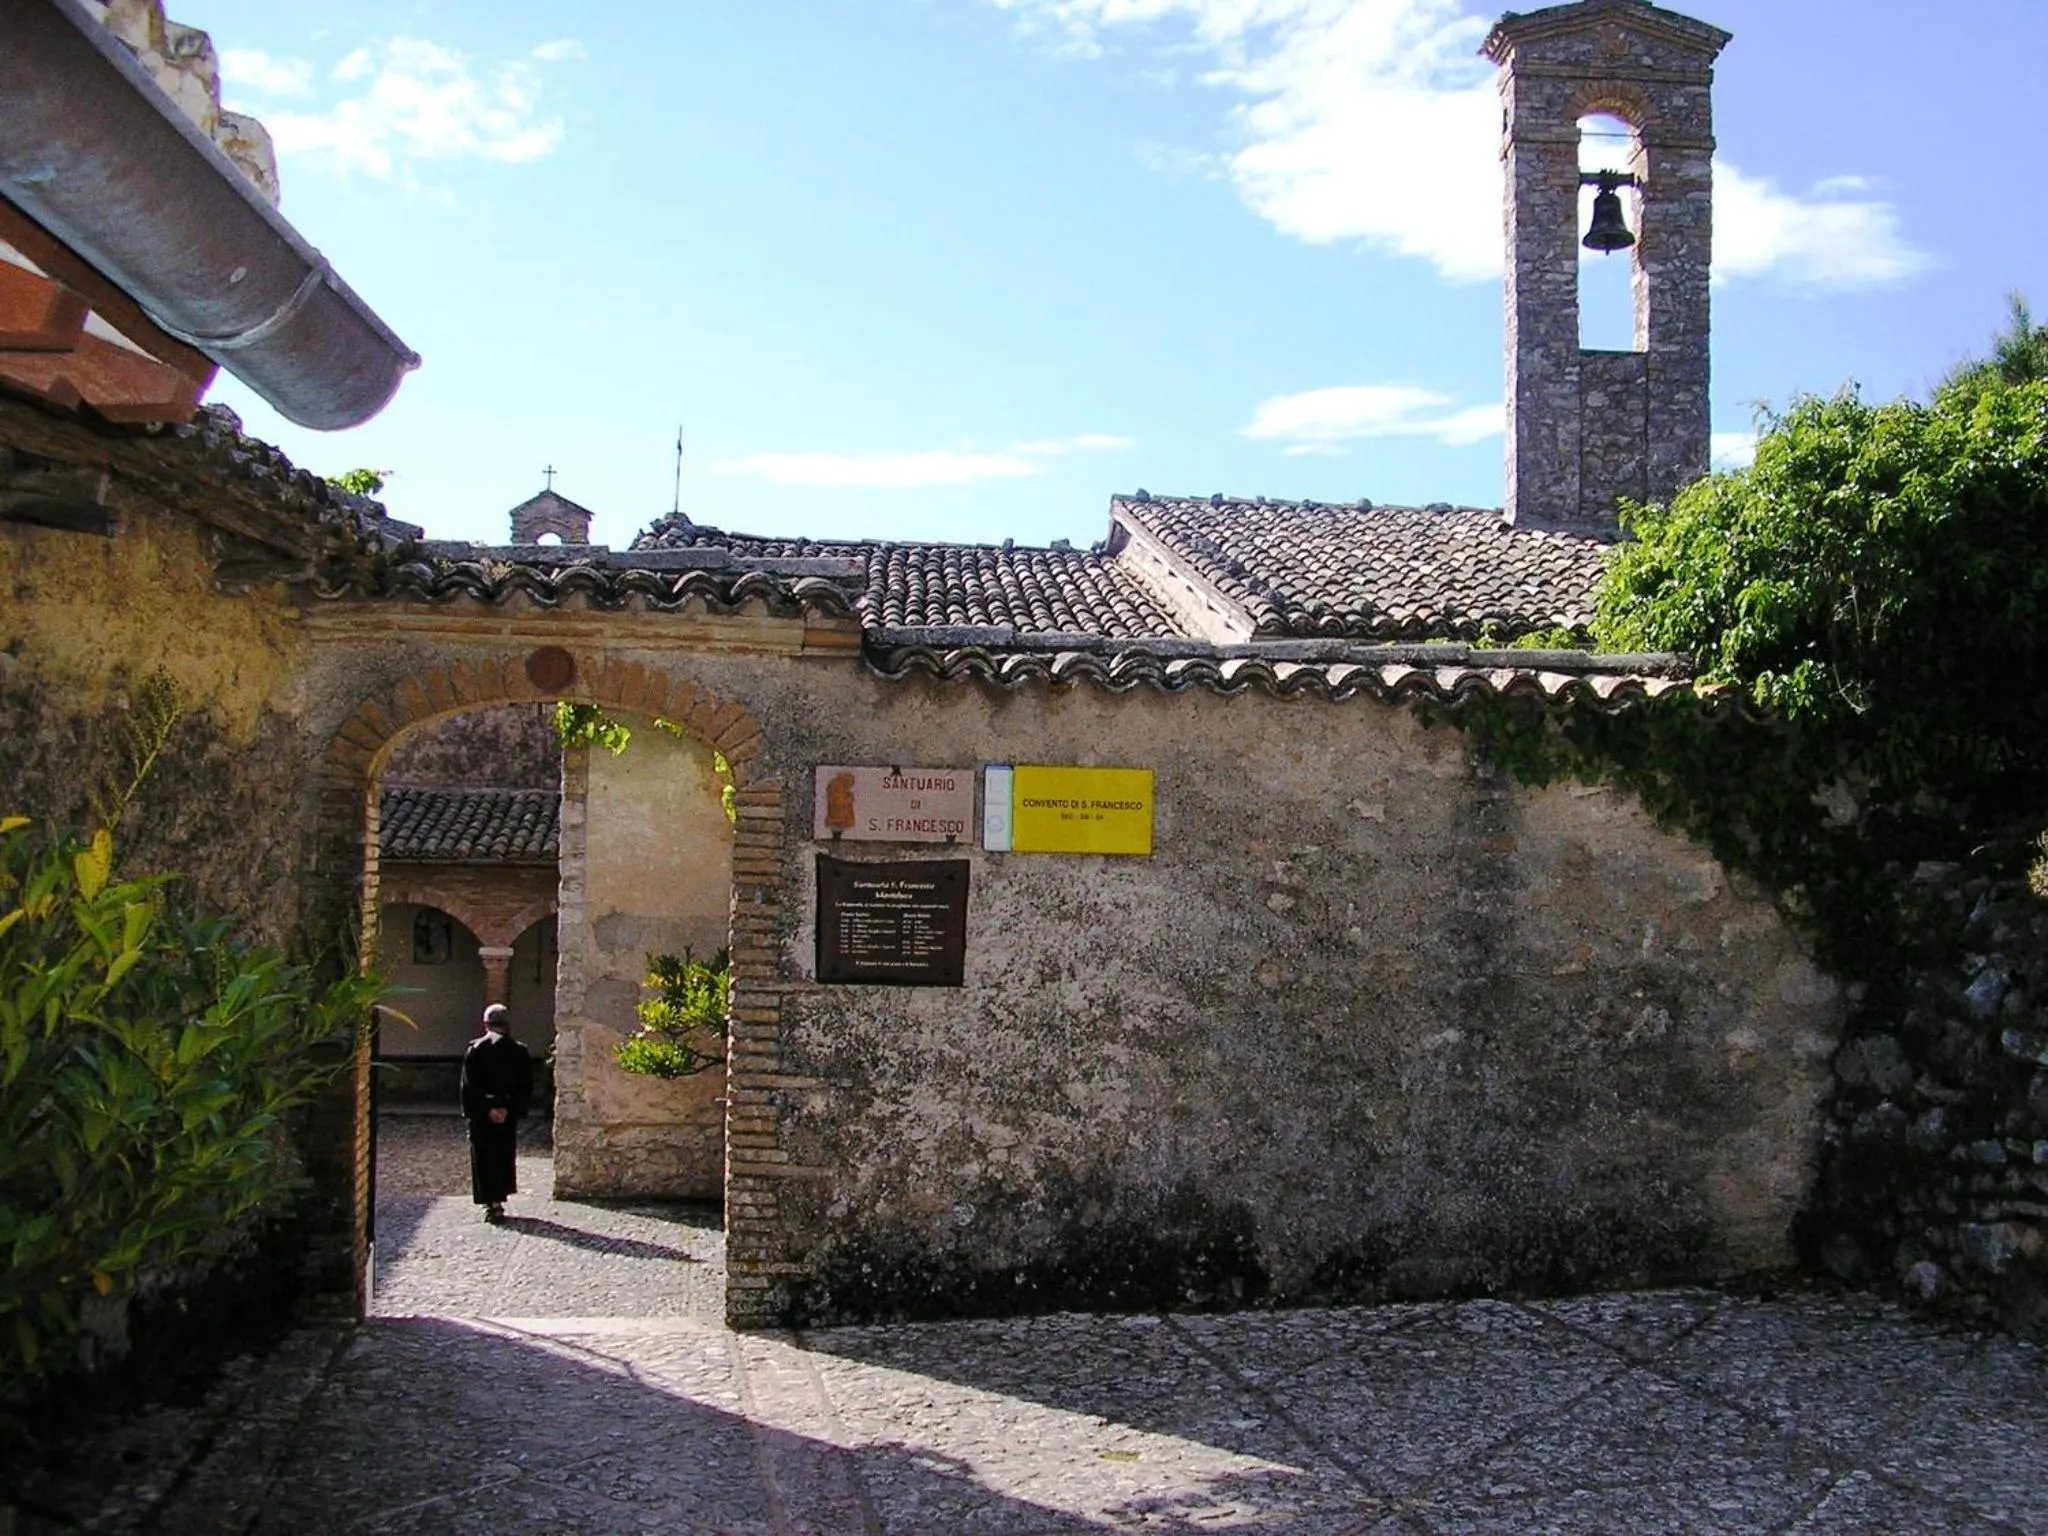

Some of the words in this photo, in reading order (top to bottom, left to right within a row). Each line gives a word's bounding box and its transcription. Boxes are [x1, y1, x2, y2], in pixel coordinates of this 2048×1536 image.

[883, 776, 955, 791] SANTUARIO
[910, 799, 921, 810] DI
[1022, 798, 1069, 809] CONVENTO
[1071, 799, 1079, 809] DI
[1090, 800, 1144, 811] FRANCESCO
[869, 818, 882, 832] S.
[887, 819, 964, 833] FRANCESCO
